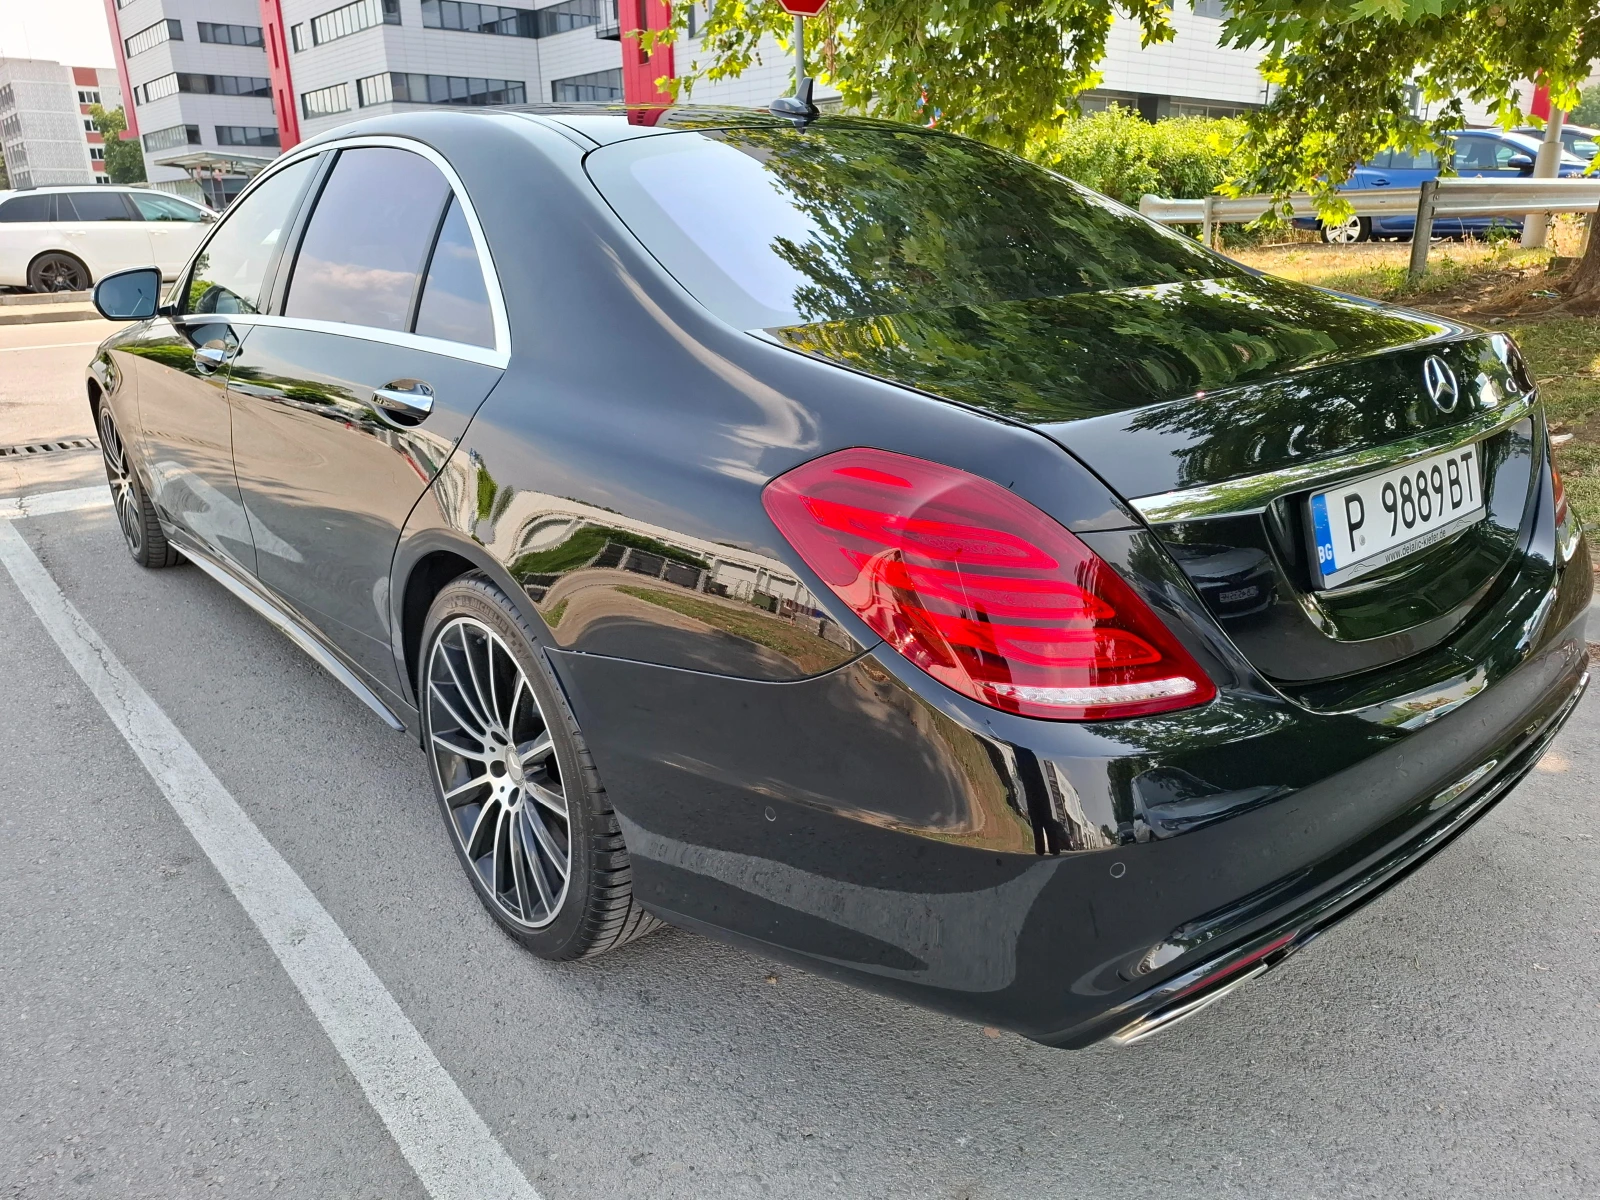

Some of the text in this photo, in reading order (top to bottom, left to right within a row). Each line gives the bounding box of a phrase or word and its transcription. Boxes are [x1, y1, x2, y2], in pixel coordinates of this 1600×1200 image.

[1344, 493, 1365, 552] P
[1318, 543, 1333, 563] BG
[470, 597, 510, 636] MICHELIN
